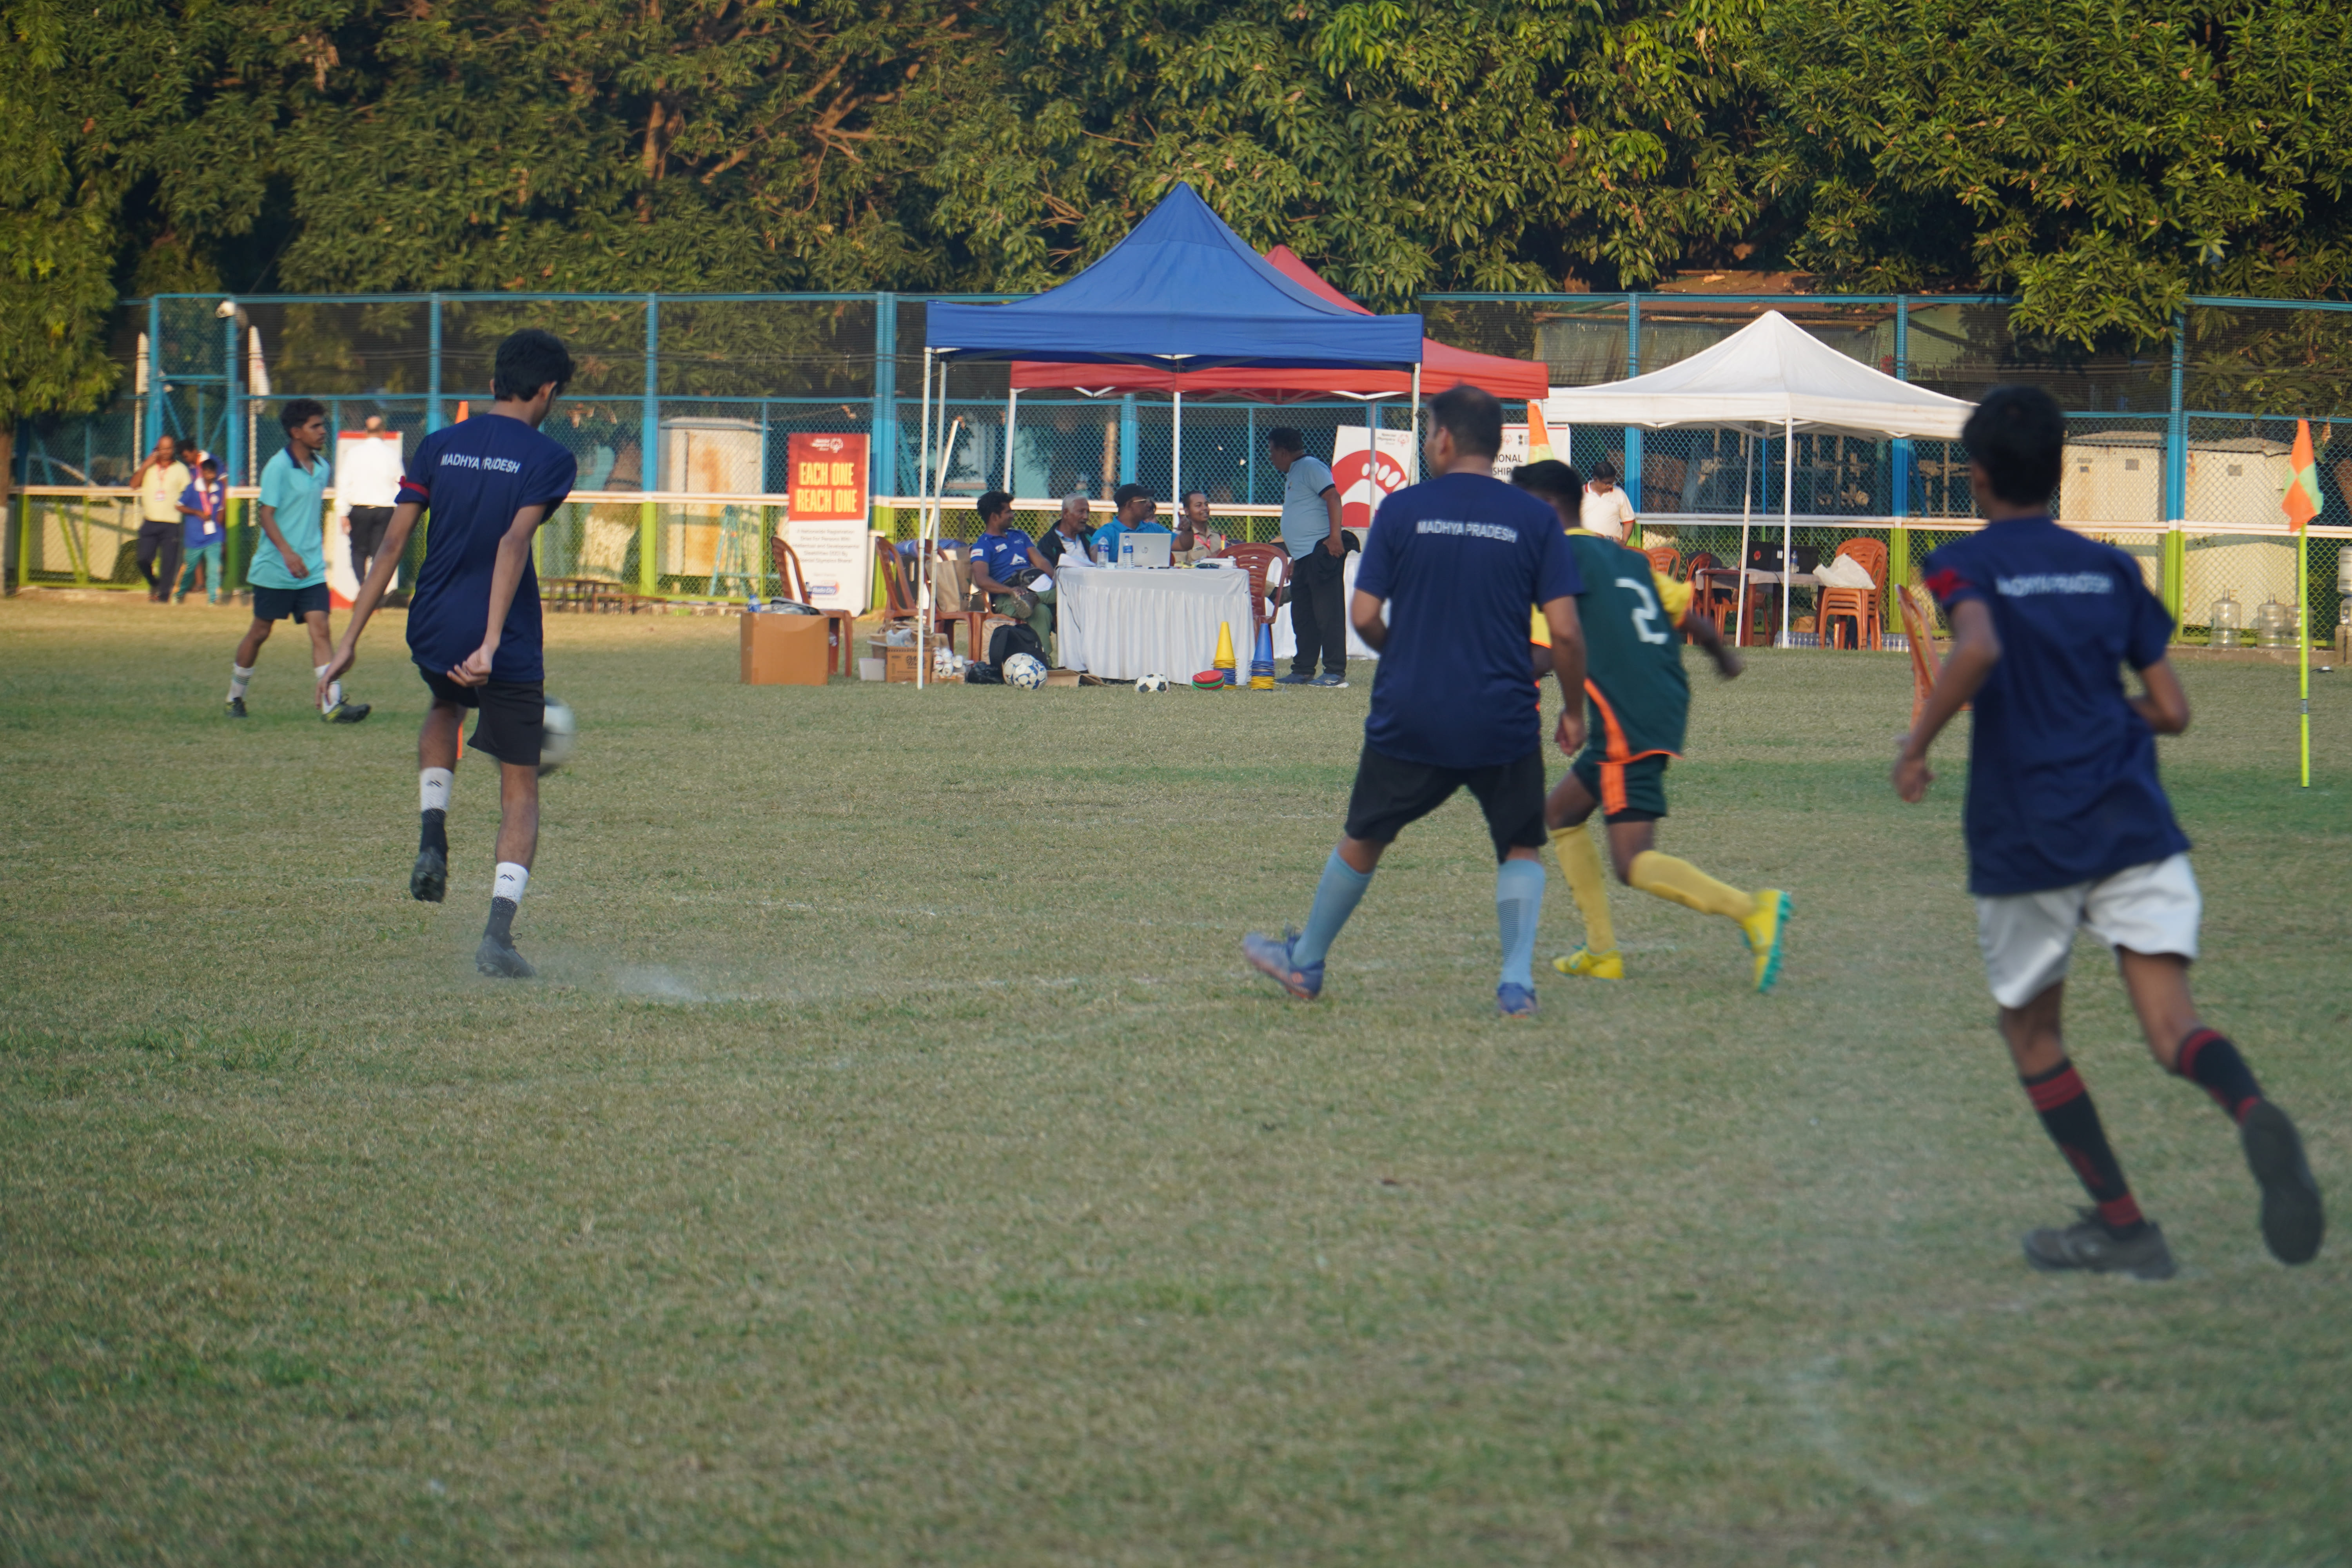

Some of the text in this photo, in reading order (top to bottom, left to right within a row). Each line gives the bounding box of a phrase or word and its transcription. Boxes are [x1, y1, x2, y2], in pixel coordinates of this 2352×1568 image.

[440, 453, 479, 470] MADHYA
[1496, 454, 1523, 463] IONAL
[799, 462, 854, 486] EACH ONE
[1492, 467, 1512, 475] SHIP
[796, 489, 858, 513] REACH ONE
[1417, 520, 1517, 543] MADHYA PRADESH
[1615, 577, 1669, 645] 2
